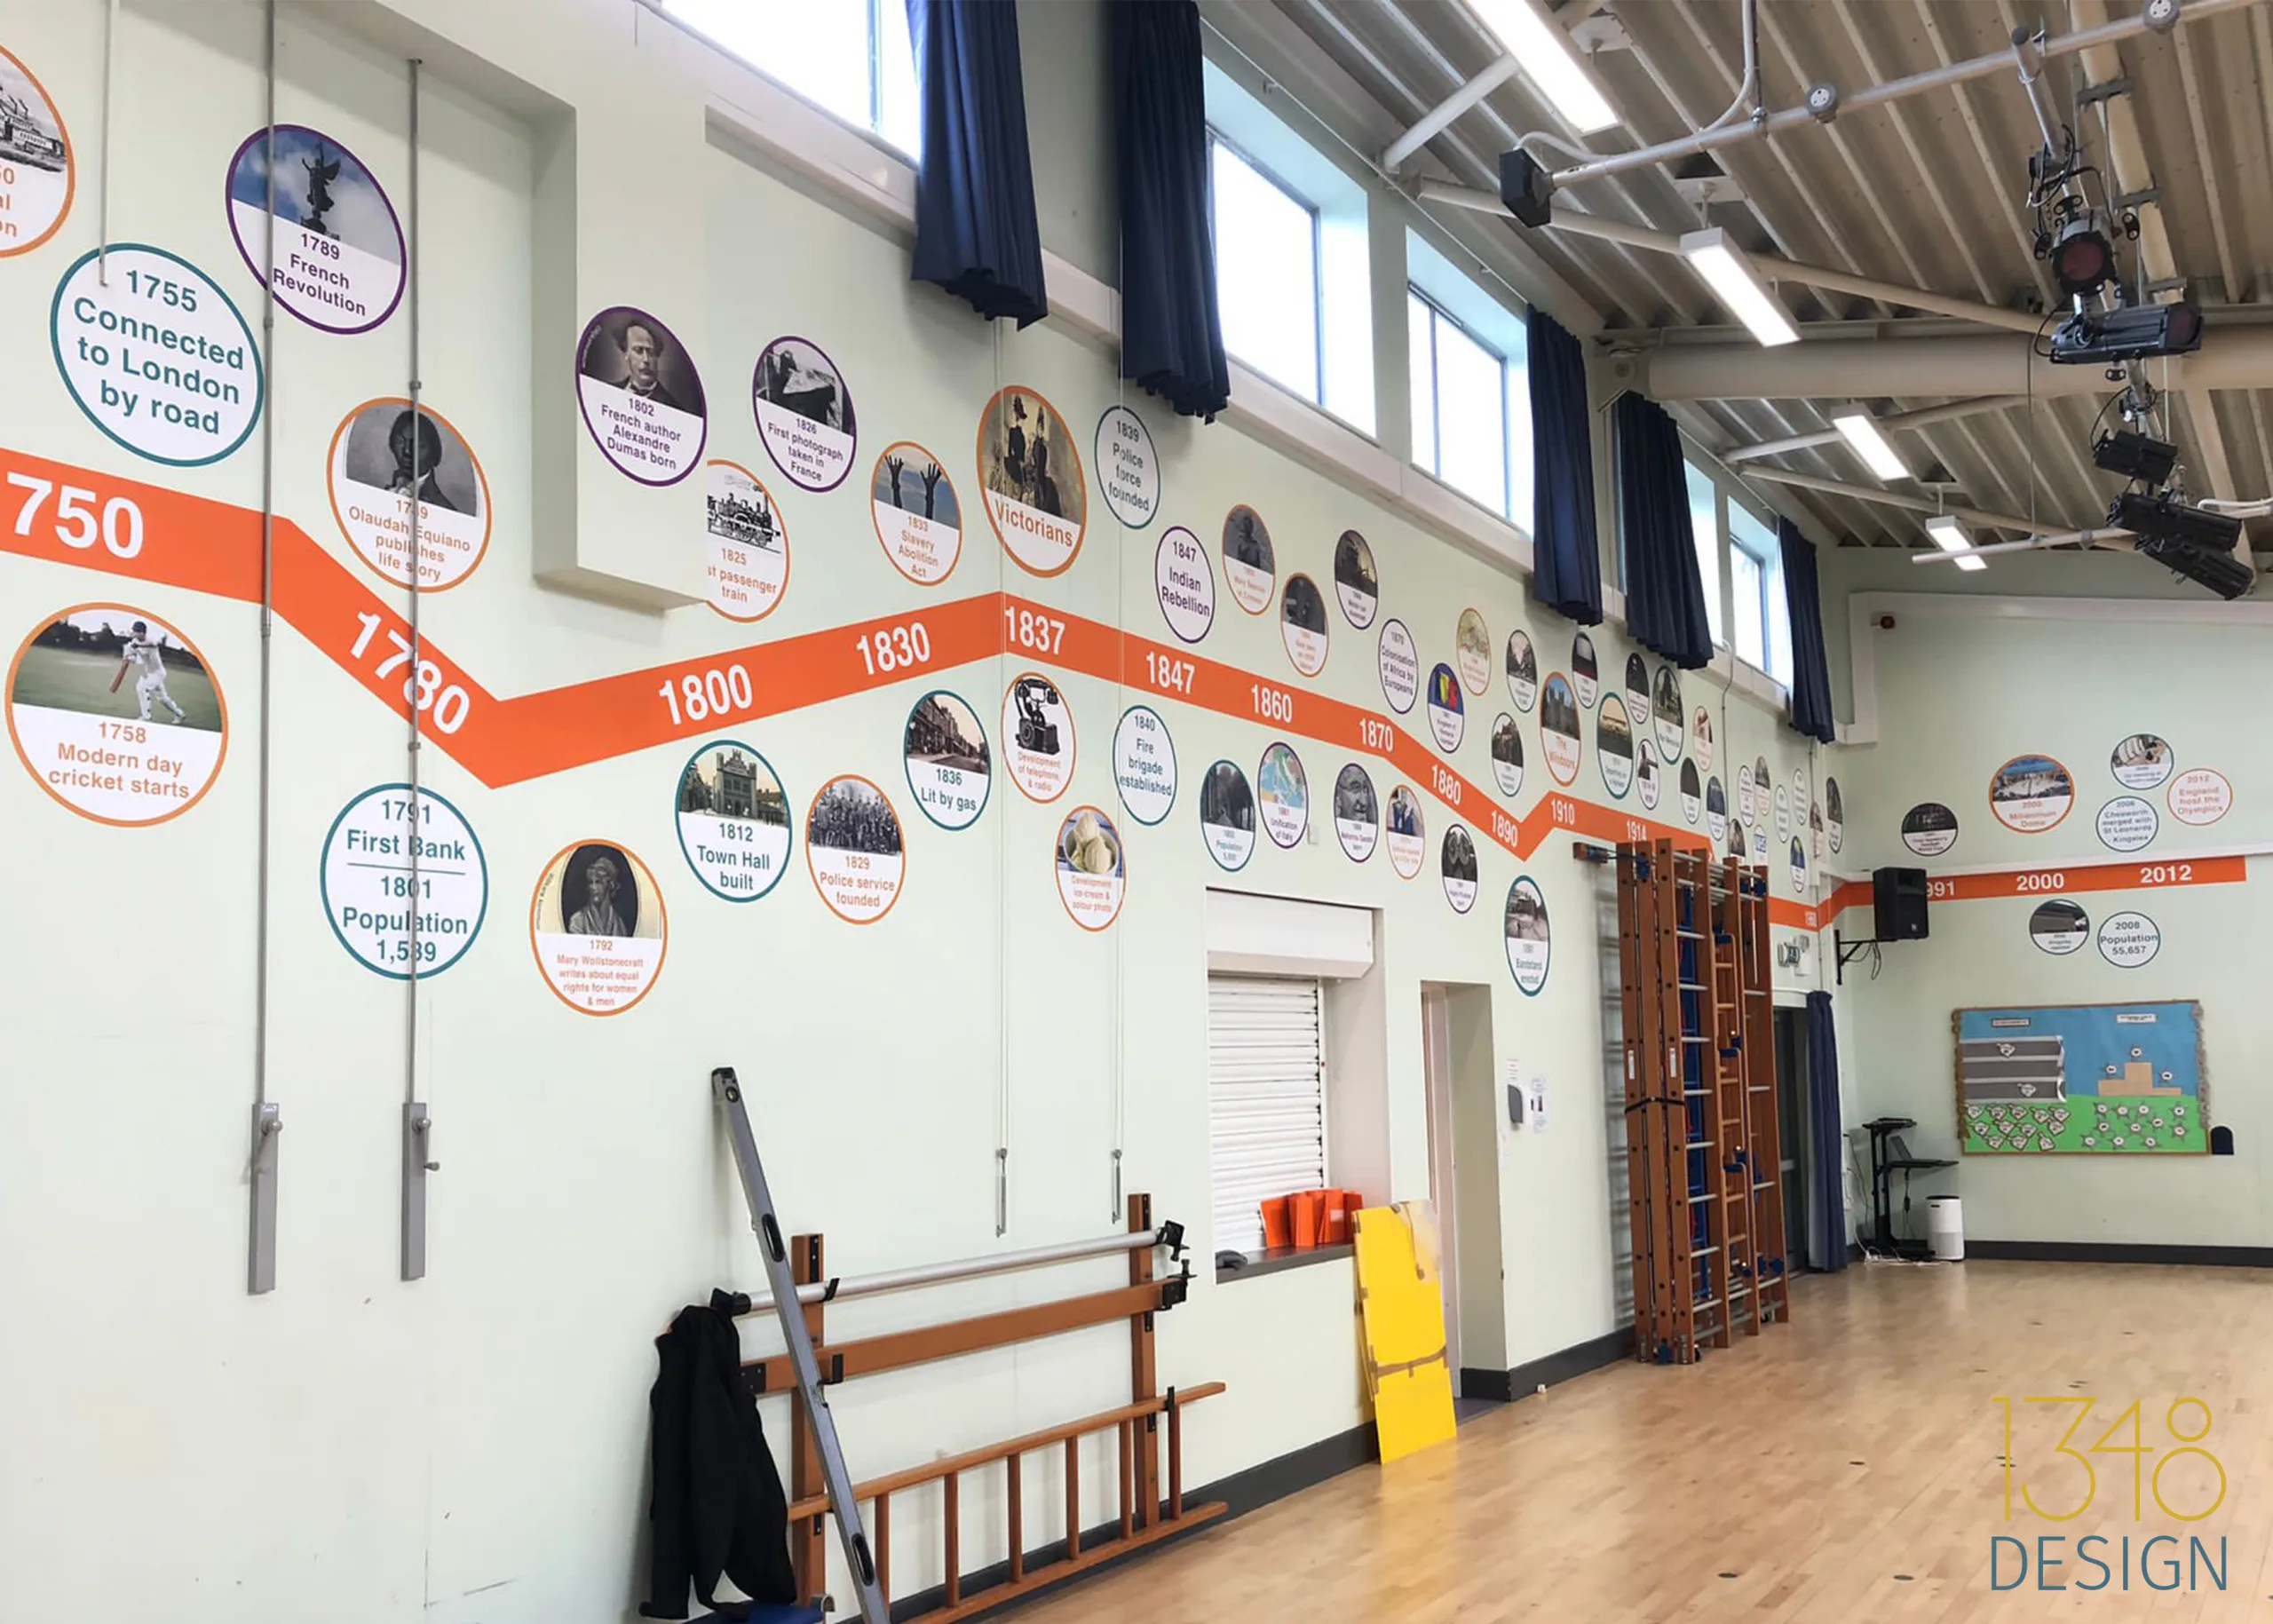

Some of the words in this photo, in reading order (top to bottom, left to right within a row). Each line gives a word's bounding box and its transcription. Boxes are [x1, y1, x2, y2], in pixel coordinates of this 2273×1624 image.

[300, 234, 340, 260] 1789
[290, 254, 349, 289] French
[126, 269, 198, 313] 1755
[273, 267, 366, 317] Revolution
[73, 297, 243, 370] Connected
[78, 336, 109, 367] to
[123, 347, 240, 404] London
[100, 379, 138, 417] by
[151, 398, 219, 434] road
[628, 399, 654, 417] 1802
[601, 404, 640, 428] French
[644, 419, 681, 442] author
[796, 417, 817, 434] 1826
[1116, 420, 1139, 443] 1839
[613, 425, 670, 453] Alexandre
[767, 423, 789, 441] First
[792, 432, 843, 462] photograph
[607, 437, 646, 461] Dumas
[650, 451, 677, 471] born
[788, 446, 812, 463] taken
[815, 456, 824, 467] in
[1113, 443, 1143, 469] Police
[791, 461, 821, 481] France
[1116, 465, 1141, 488] force
[1109, 482, 1149, 511] founded
[6, 471, 145, 559] 750
[349, 506, 408, 533] Olaudah
[396, 500, 428, 519] 179
[994, 499, 1073, 548] Victorians
[376, 536, 445, 562] publihes
[901, 530, 935, 551] Slavery
[1173, 541, 1196, 563] 1847
[379, 552, 400, 568] life
[406, 561, 441, 582] sory
[721, 548, 747, 566] 1825
[899, 546, 939, 567] Abolition
[720, 569, 777, 594] passenger
[911, 564, 926, 578] Act
[1169, 566, 1200, 592] Indian
[722, 585, 748, 602] train
[1161, 587, 1209, 617] Rebellion
[1004, 606, 1065, 655] 1837
[856, 622, 930, 676] 1830
[351, 611, 470, 734] 1780
[1145, 651, 1195, 694] 1847
[659, 664, 752, 725] 1800
[1251, 684, 1293, 724] 1860
[98, 722, 147, 744] 1758
[1135, 715, 1154, 731] 1840
[1359, 717, 1394, 753] 1870
[1136, 738, 1153, 755] Fire
[58, 743, 139, 769] Modern
[147, 749, 183, 777] day
[1129, 757, 1163, 776] brigade
[48, 769, 124, 793] cricket
[131, 774, 190, 798] starts
[936, 768, 962, 786] 1836
[1120, 774, 1172, 796] established
[1431, 764, 1461, 805] 1880
[921, 788, 936, 804] Lit
[939, 792, 953, 810] by
[955, 797, 977, 812] gas
[1551, 798, 1575, 826] 1910
[719, 823, 753, 842] 1812
[1491, 810, 1517, 848] 1890
[1627, 820, 1647, 841] 1914
[347, 829, 400, 855] First
[408, 836, 465, 861] Bank
[697, 845, 737, 866] Town
[742, 850, 770, 869] Hall
[845, 856, 870, 870] 1829
[2141, 864, 2192, 883] 2012
[720, 872, 754, 890] built
[820, 872, 853, 888] Police
[857, 877, 895, 891] service
[1927, 881, 1954, 898] 991
[2016, 873, 2064, 891] 2000
[836, 891, 880, 907] founded
[343, 907, 468, 935] Population
[2115, 921, 2140, 930] 2008
[590, 939, 613, 951] 1792
[2100, 933, 2158, 945] Population
[558, 955, 578, 967] Mary
[559, 970, 586, 979] writes
[589, 970, 614, 980] about
[615, 971, 639, 982] equal
[563, 983, 590, 994] rights
[592, 983, 605, 993] for
[606, 985, 638, 994] women
[596, 997, 615, 1006] men
